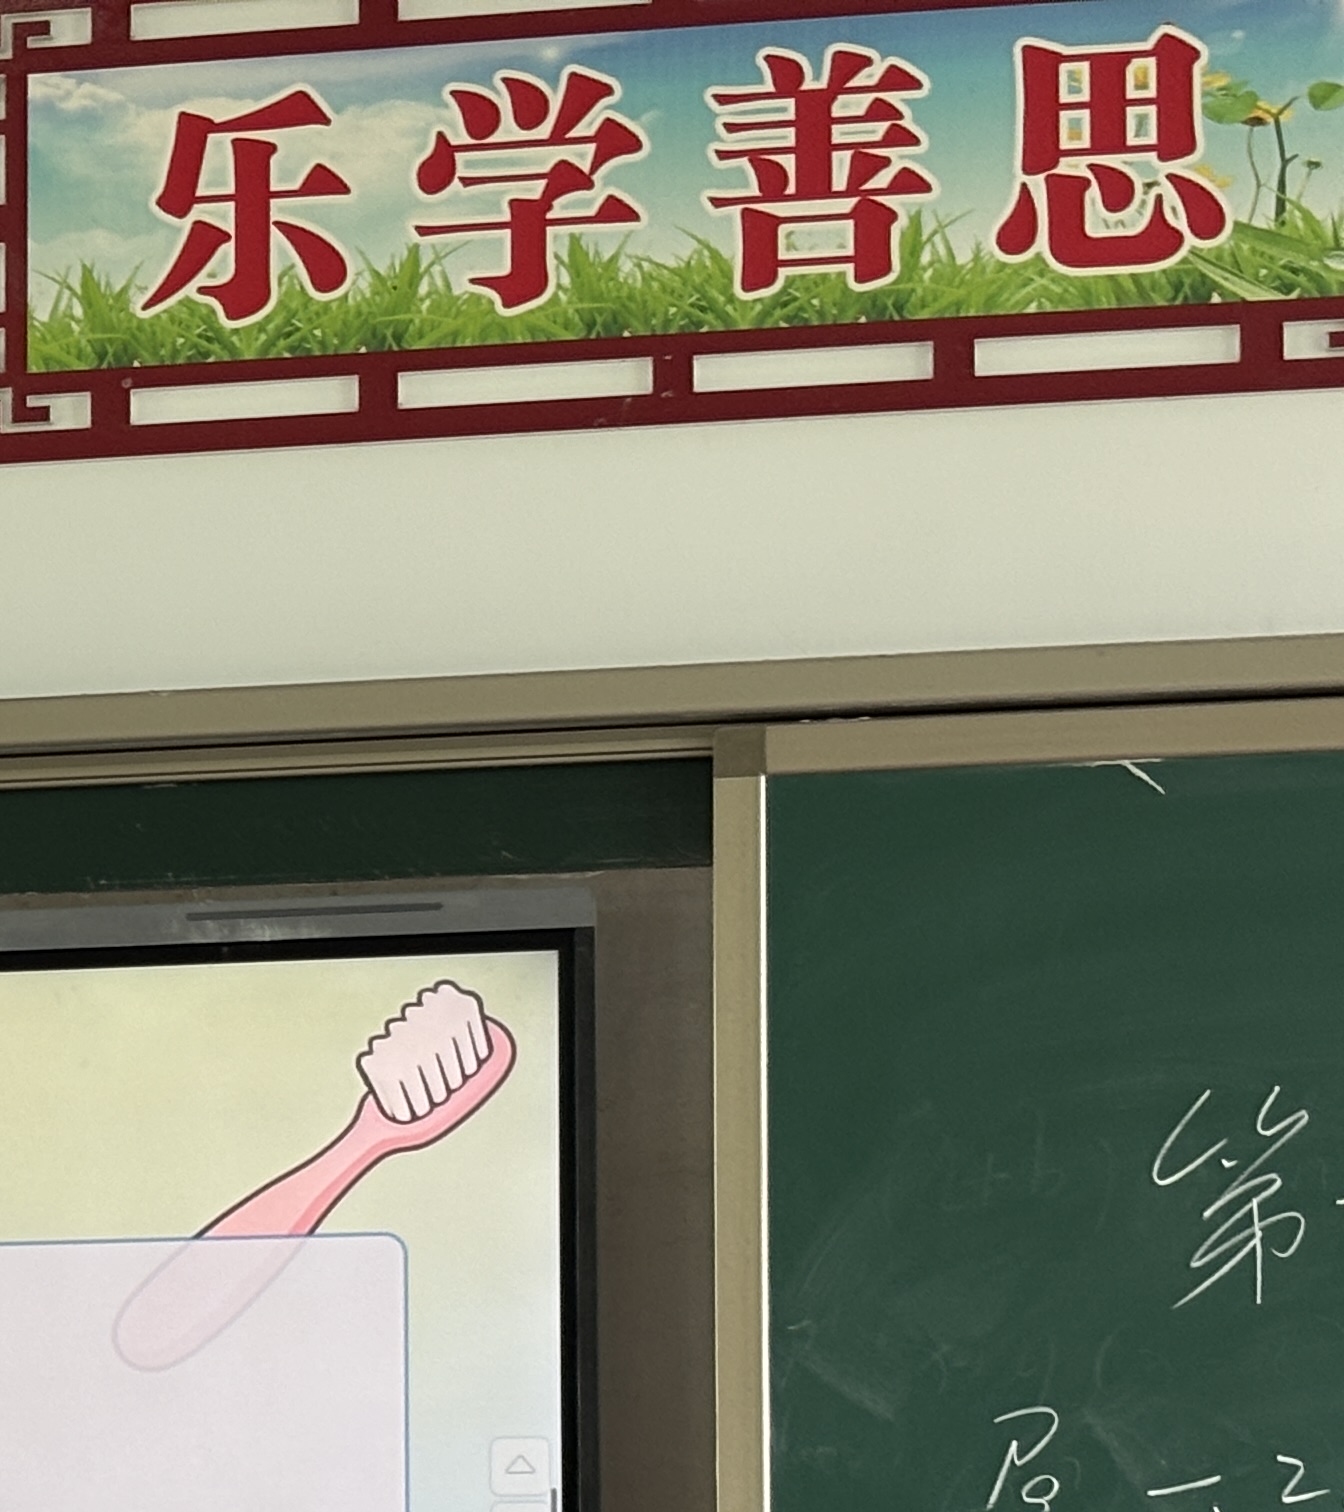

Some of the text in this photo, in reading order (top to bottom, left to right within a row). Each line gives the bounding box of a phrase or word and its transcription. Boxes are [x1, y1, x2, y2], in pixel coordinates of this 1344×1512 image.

[135, 20, 1231, 328] 乐学善思
[1152, 1085, 1344, 1310] 第
